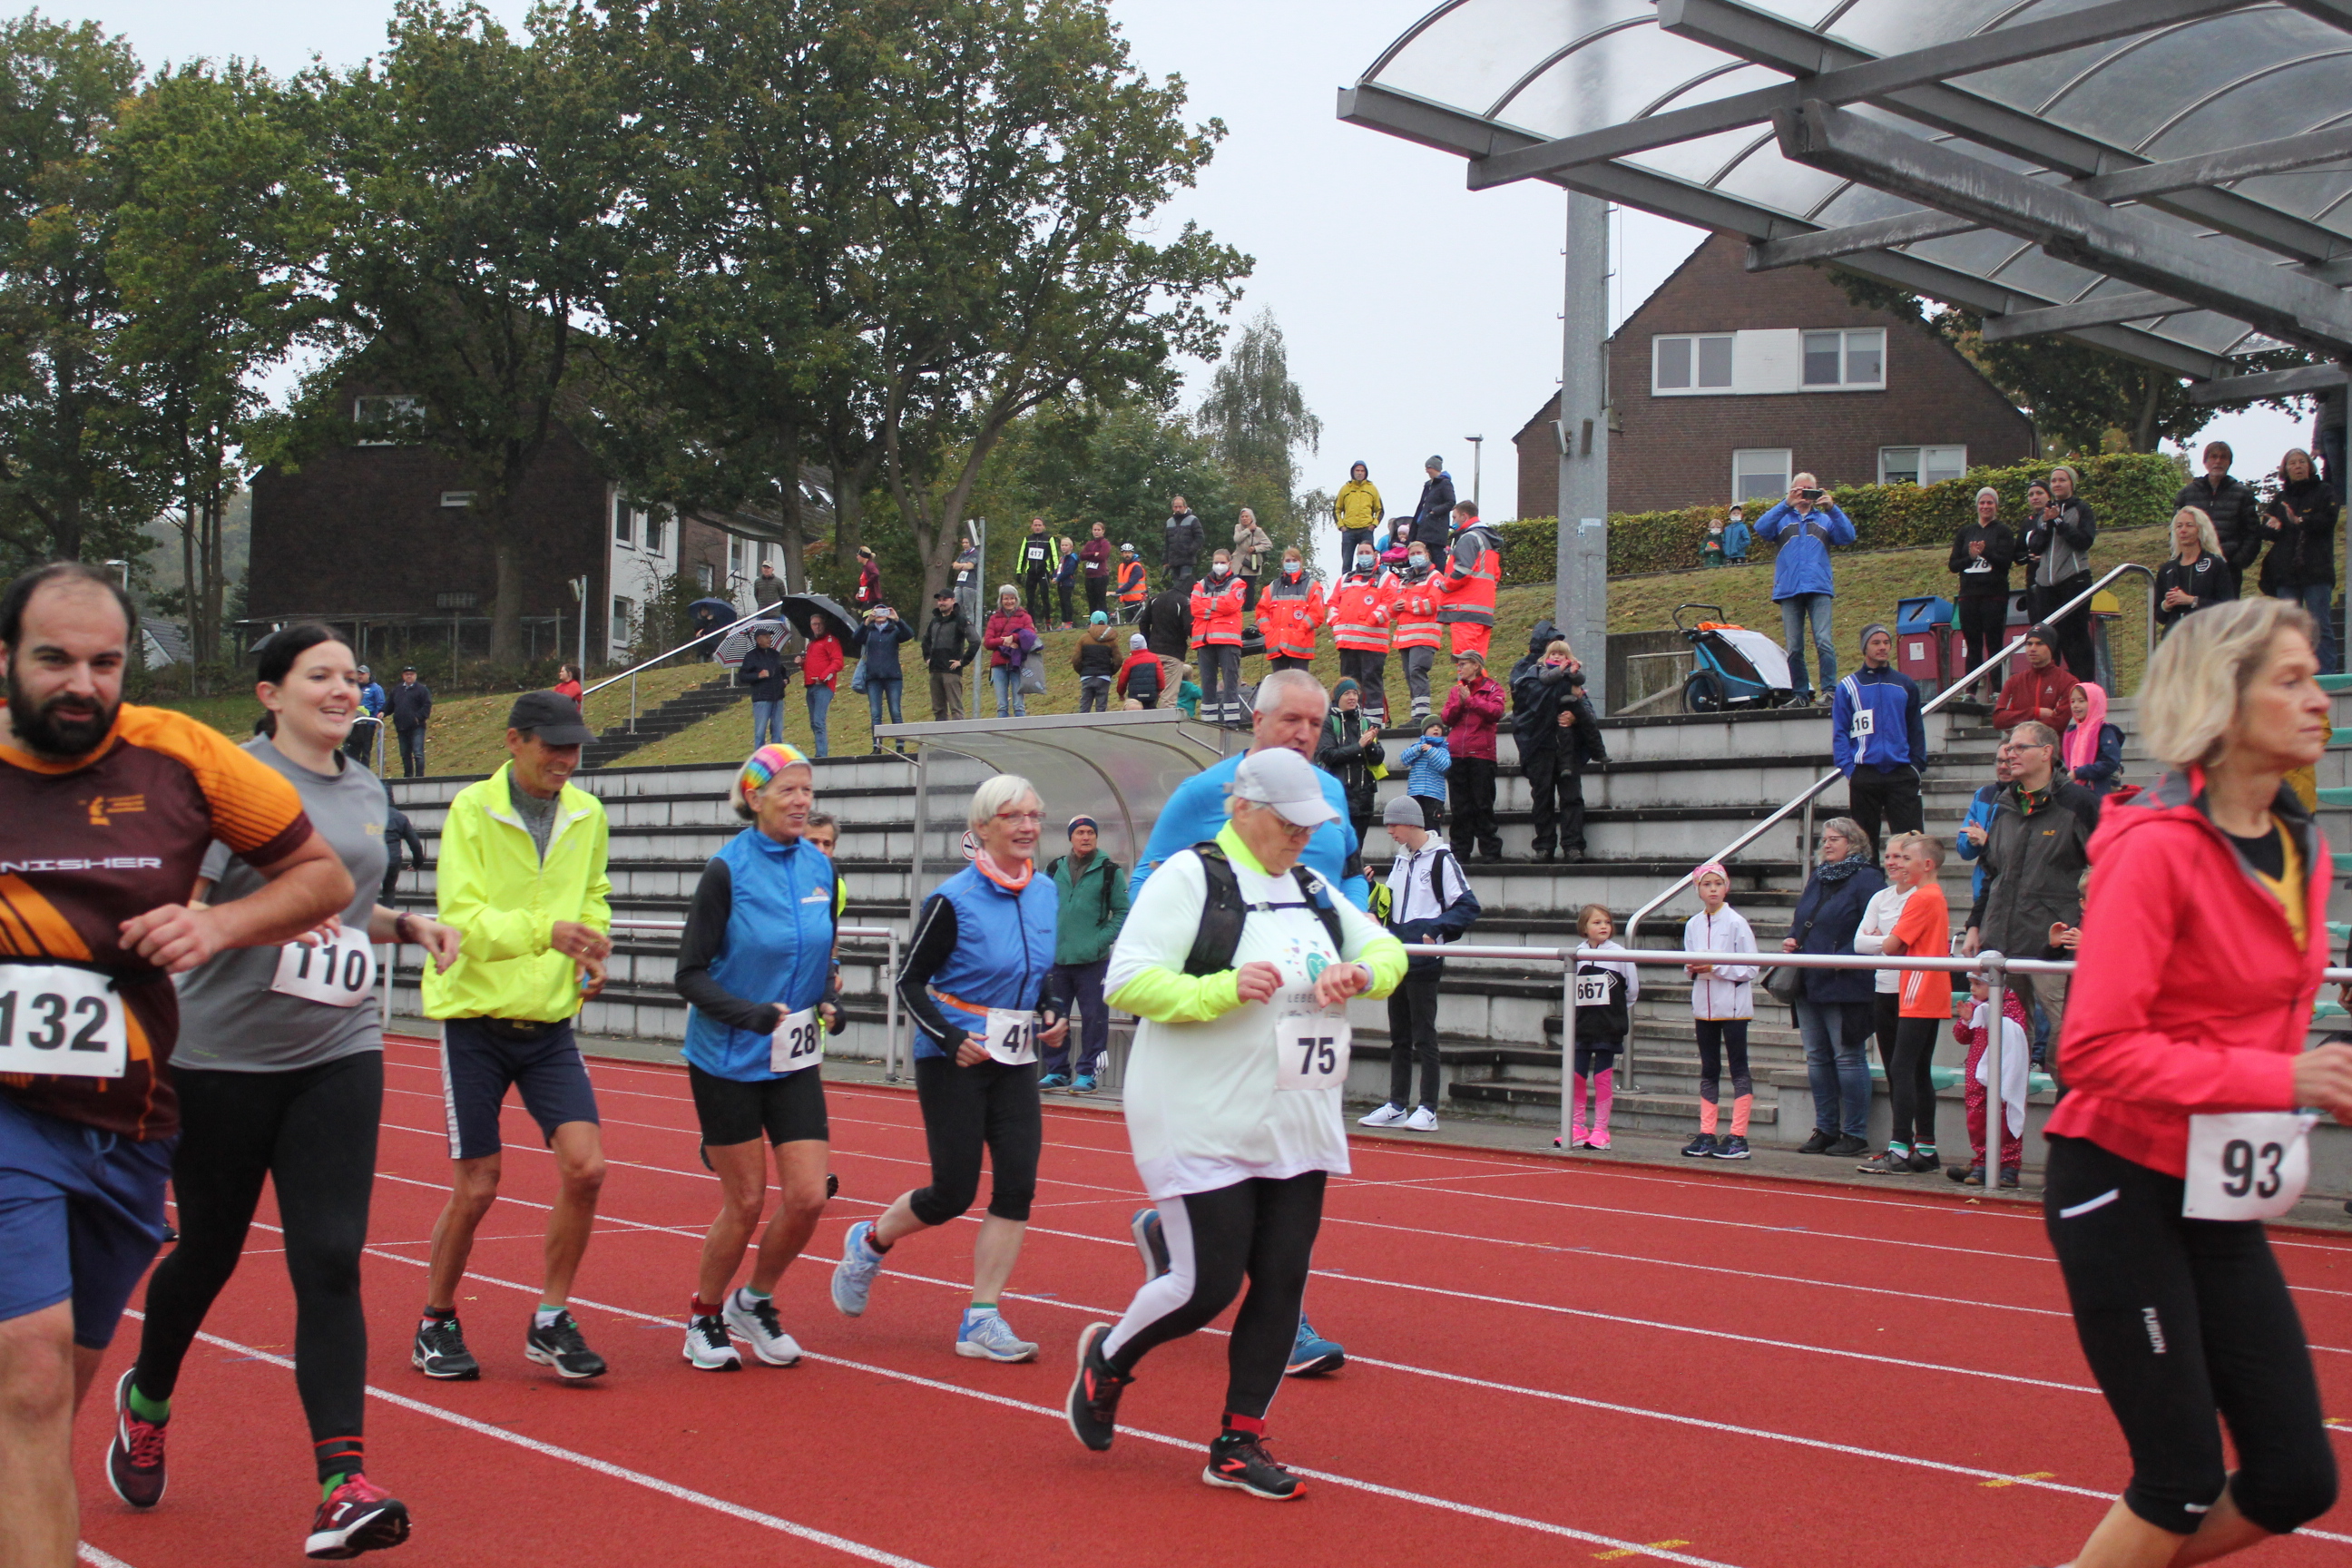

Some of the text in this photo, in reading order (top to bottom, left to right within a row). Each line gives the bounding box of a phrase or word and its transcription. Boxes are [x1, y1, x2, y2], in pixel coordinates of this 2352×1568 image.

[1973, 558, 1988, 569] 76
[296, 940, 367, 993] 110
[1577, 982, 1604, 1000] 667
[0, 989, 109, 1053] 132
[1002, 1024, 1030, 1054] 41
[789, 1023, 817, 1059] 28
[1298, 1036, 1337, 1074] 75
[2222, 1138, 2283, 1200] 93
[2141, 1307, 2168, 1354] FUSION
